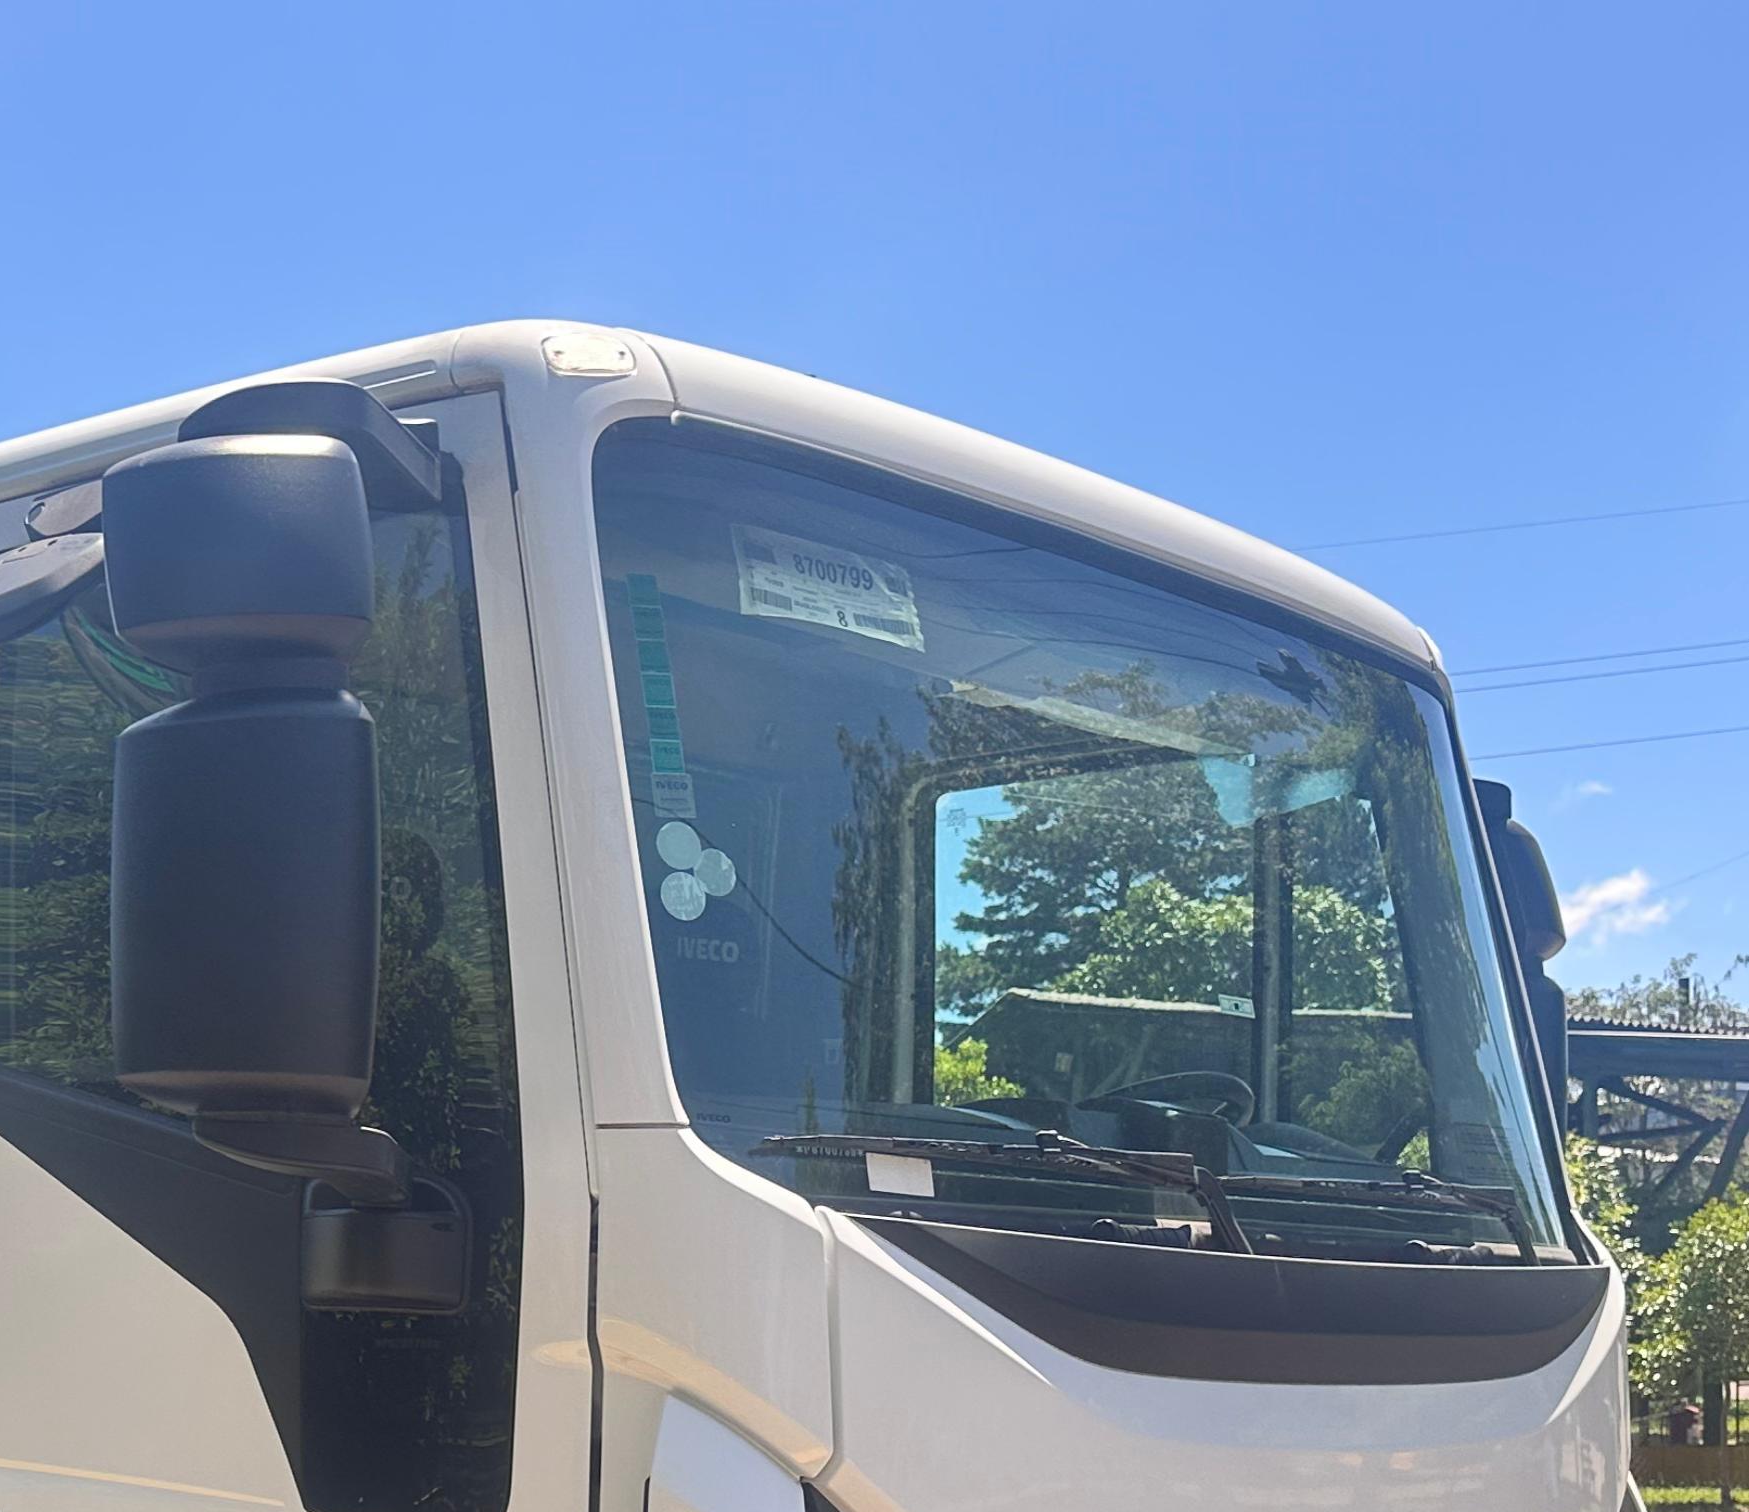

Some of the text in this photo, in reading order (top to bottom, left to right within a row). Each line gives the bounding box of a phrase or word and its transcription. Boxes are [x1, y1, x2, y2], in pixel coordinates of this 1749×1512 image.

[791, 553, 875, 591] 8700799
[836, 610, 849, 628] 8
[655, 779, 689, 791] IVECO
[676, 936, 740, 963] IVECO
